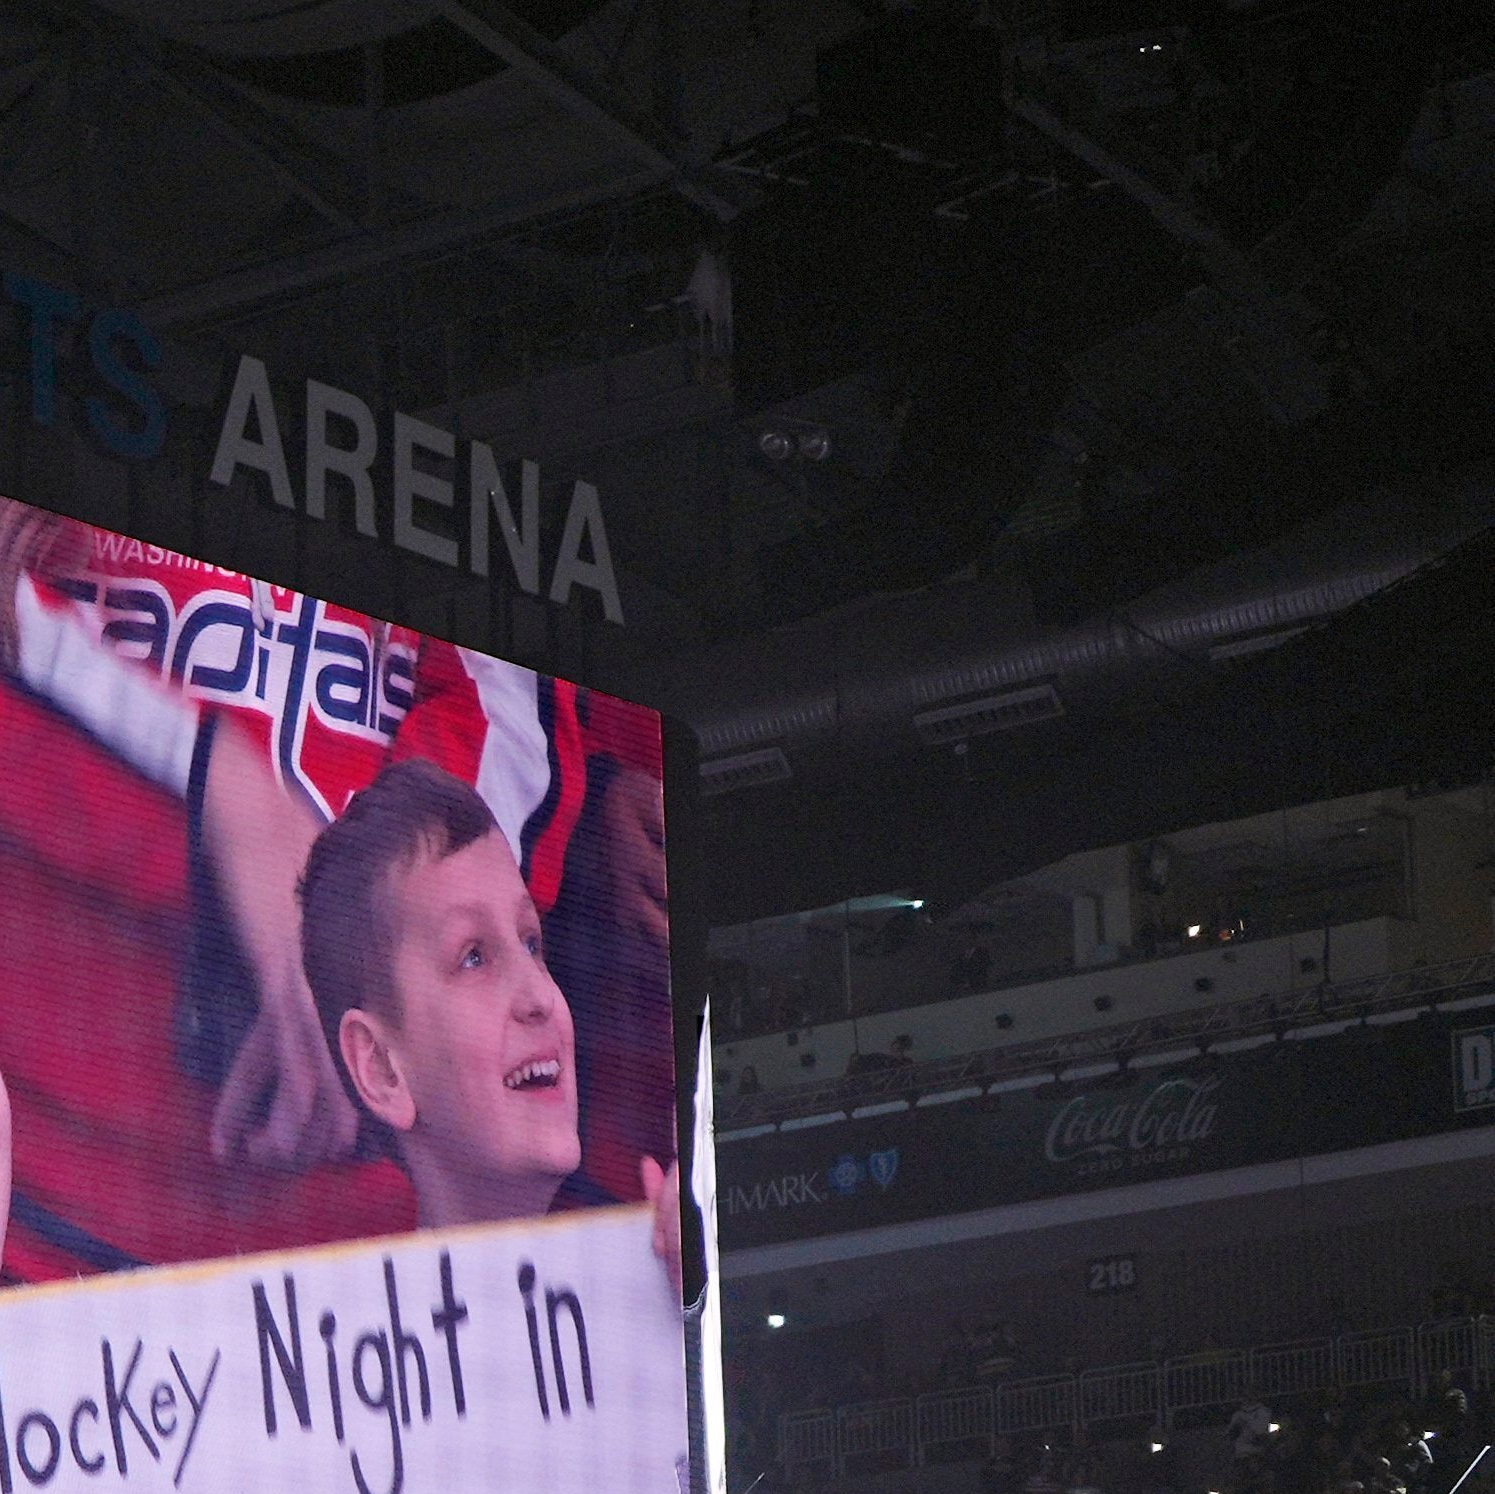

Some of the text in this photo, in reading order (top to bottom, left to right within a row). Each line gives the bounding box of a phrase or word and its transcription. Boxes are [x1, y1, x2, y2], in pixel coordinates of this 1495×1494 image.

[209, 354, 626, 628] ARENA
[517, 1259, 595, 1423] in
[1089, 1259, 1136, 1291] 218
